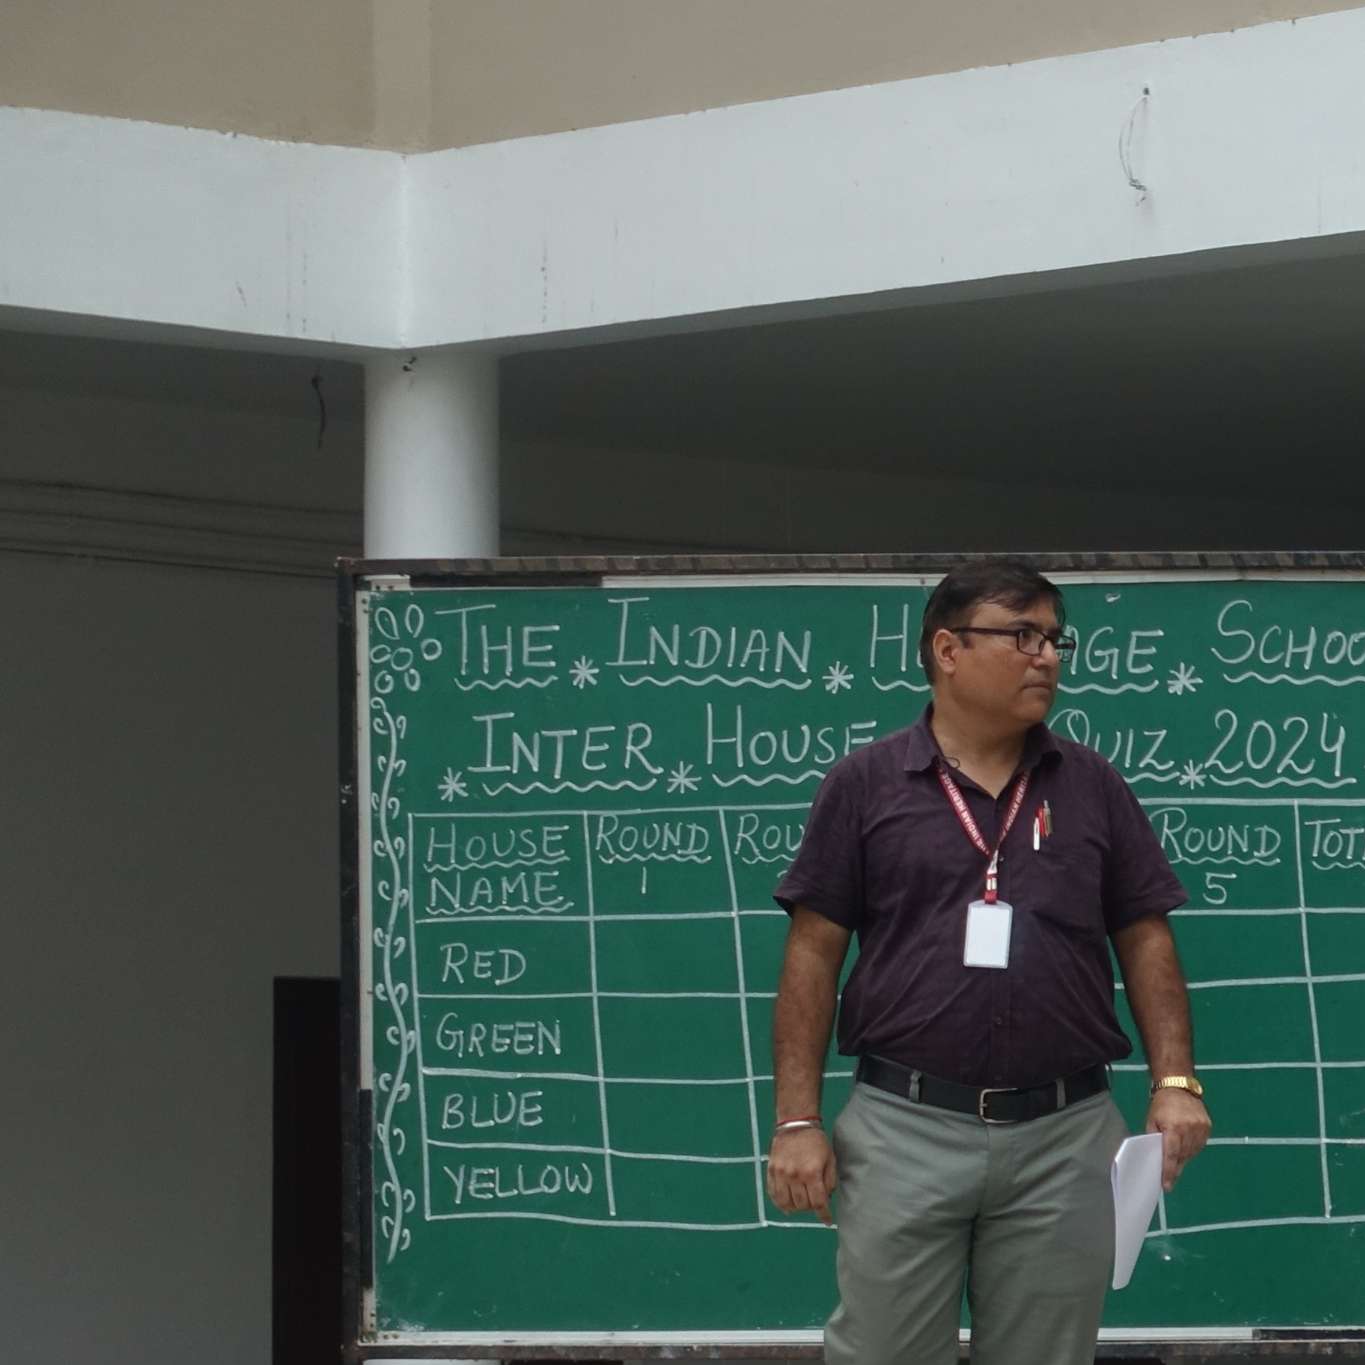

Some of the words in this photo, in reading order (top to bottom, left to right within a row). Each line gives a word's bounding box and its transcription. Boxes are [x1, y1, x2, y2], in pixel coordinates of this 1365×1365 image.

[435, 604, 561, 676] THE
[606, 597, 811, 673] INDIAN
[468, 712, 664, 779] INTER
[706, 702, 877, 768] HOUSE
[1205, 709, 1345, 777] 2024
[426, 825, 569, 863] HOUSE
[595, 814, 710, 856] ROUND
[734, 813, 806, 857] ROU
[1150, 807, 1281, 858] ROUND
[429, 870, 563, 908] NAME
[1203, 872, 1238, 905] 5
[440, 943, 527, 985] RED
[435, 1012, 562, 1057] GREEN
[441, 1090, 544, 1131] BLUE
[444, 1163, 594, 1204] YELLOW
